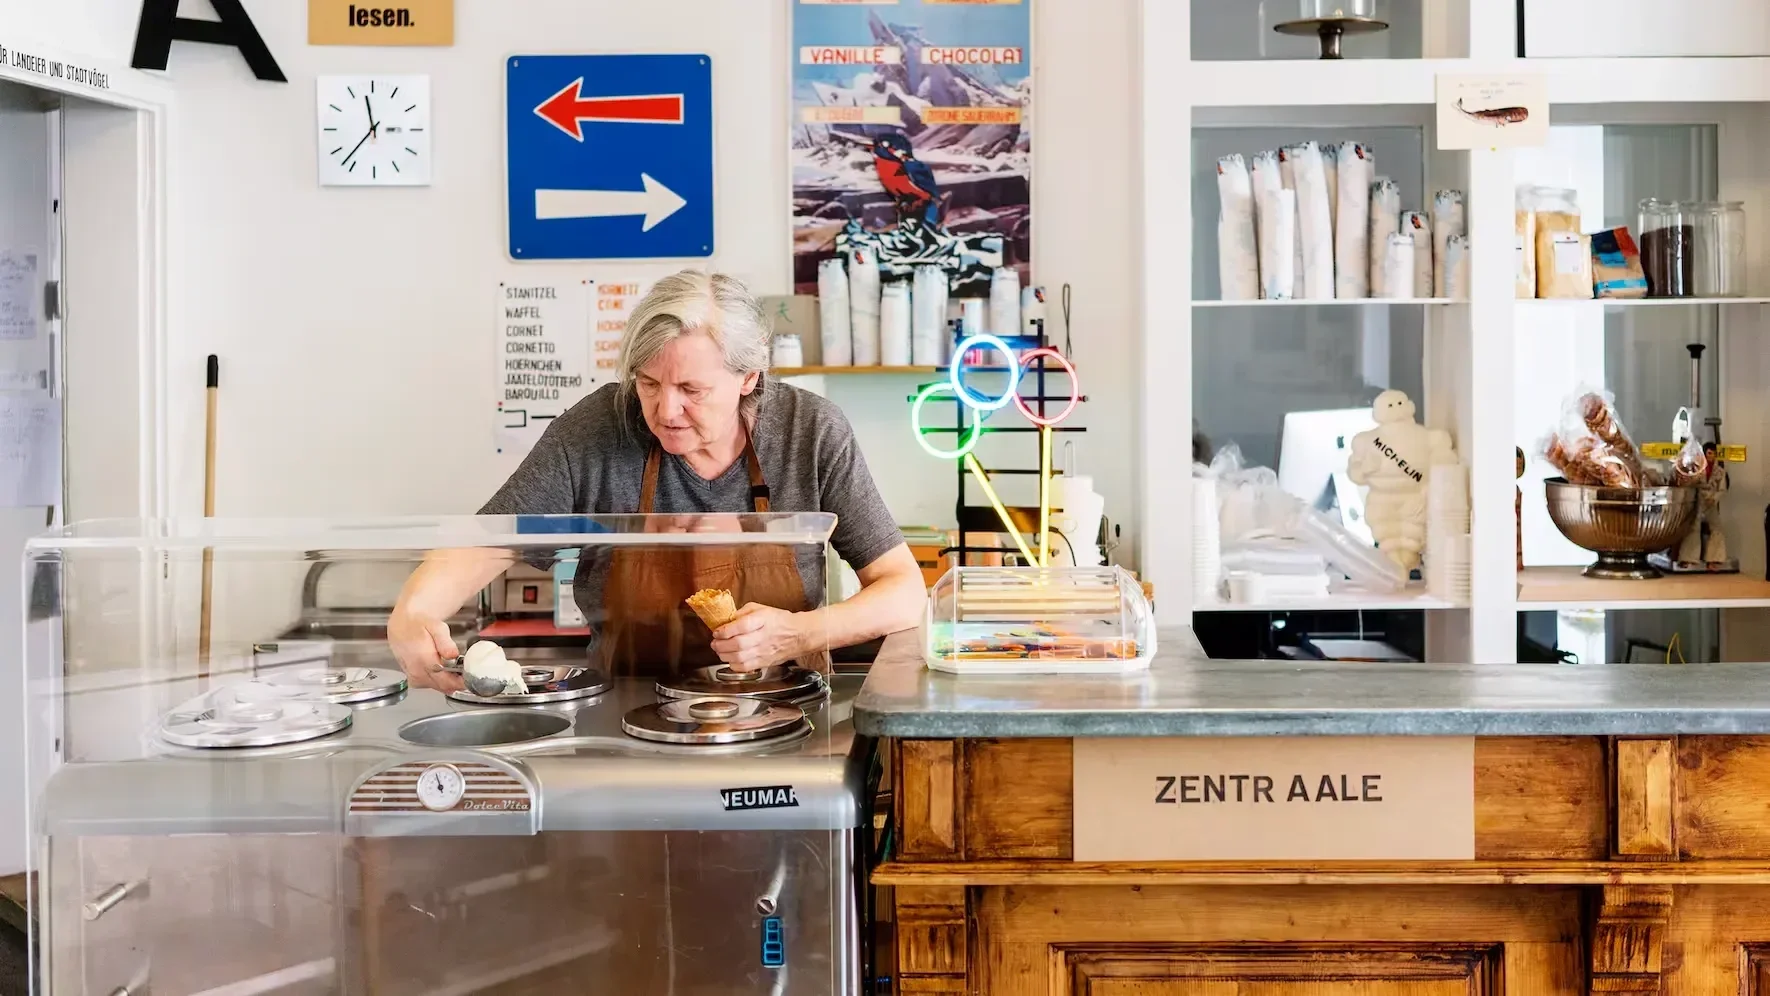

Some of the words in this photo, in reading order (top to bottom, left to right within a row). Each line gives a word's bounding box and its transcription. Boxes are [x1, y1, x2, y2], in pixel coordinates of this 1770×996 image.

[348, 4, 415, 28] lesen.
[811, 48, 885, 64] VANILLE
[929, 48, 1024, 64] CHOCOLAT
[11, 50, 46, 74] LANDEIER
[49, 61, 63, 78] UND
[506, 287, 557, 299] STANITZEL
[505, 306, 541, 319] WAFFEL
[506, 324, 544, 337] CORNET
[506, 342, 556, 354] CORNETTO
[505, 359, 562, 371] HOERNCHEN
[505, 388, 560, 401] BARQUILLO
[1373, 437, 1424, 483] MICHELIN
[464, 799, 501, 810] Dolce
[502, 799, 530, 810] Vita
